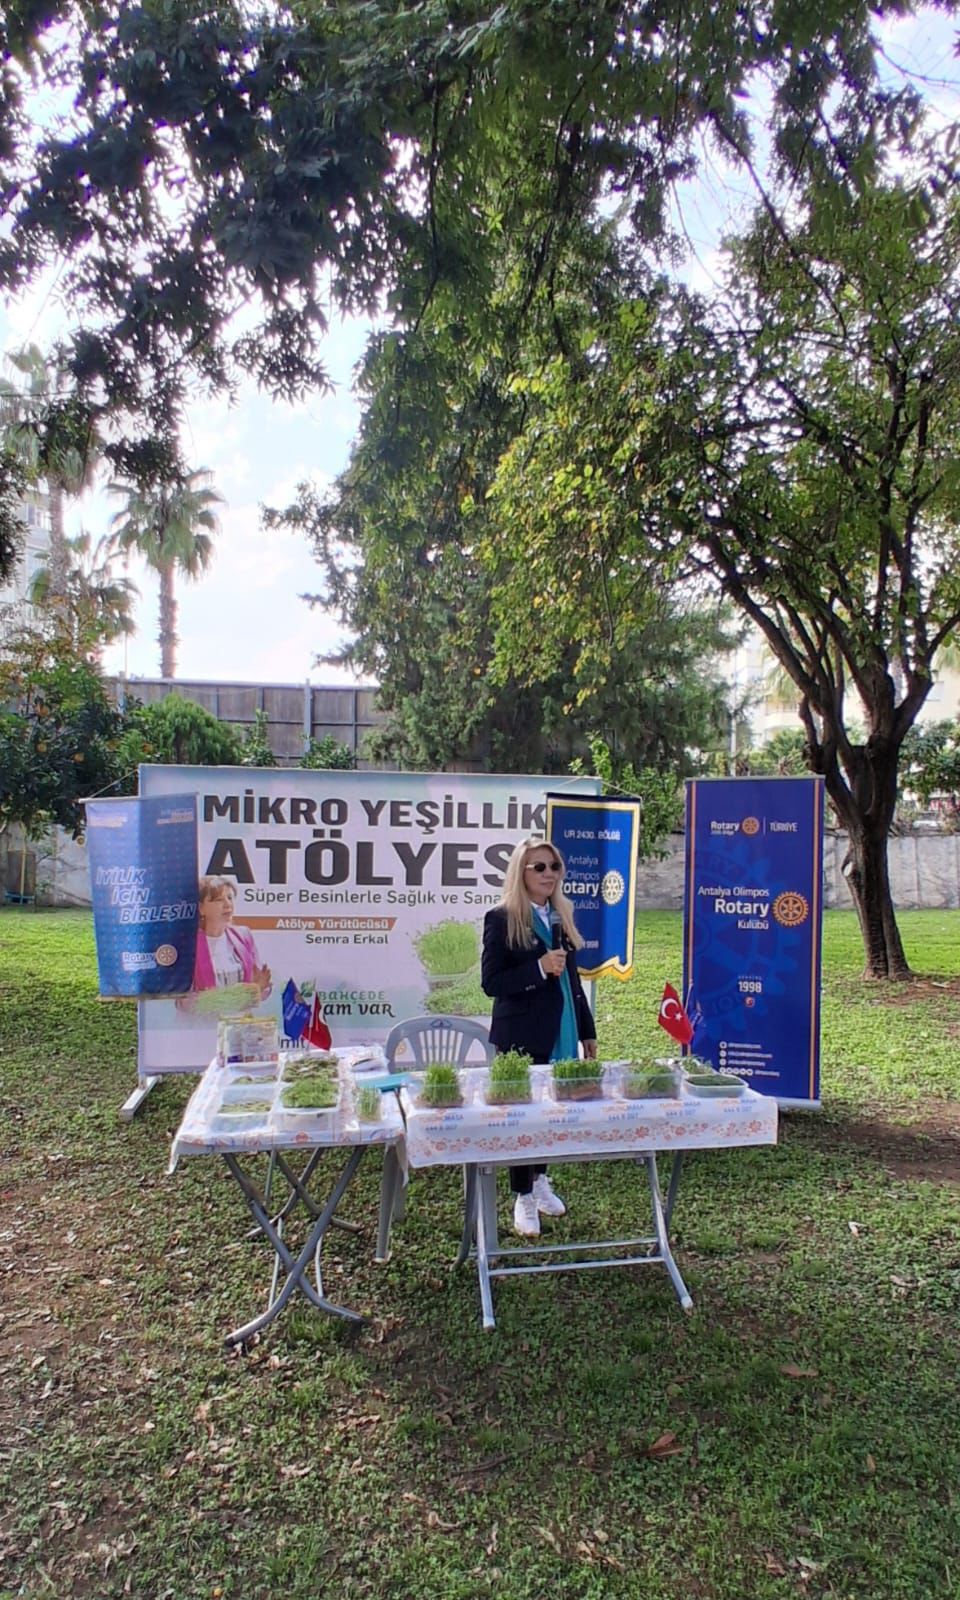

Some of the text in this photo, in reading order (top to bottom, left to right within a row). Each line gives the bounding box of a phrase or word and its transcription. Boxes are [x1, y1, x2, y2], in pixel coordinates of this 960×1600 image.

[203, 789, 546, 834] MİKRO YEŞİLLİK
[710, 821, 739, 832] Rotary
[205, 829, 543, 887] ATÖLYES
[568, 856, 598, 868] Antalya
[244, 888, 293, 905] Süper
[299, 889, 381, 904] Besinlerle
[387, 890, 435, 907] Sağlık
[441, 895, 458, 904] ve
[698, 886, 769, 898] Antalya Olimpos
[714, 899, 769, 917] Rotary
[276, 918, 389, 931] Atölye Yürütücüsü
[737, 919, 769, 930] Kulübü
[306, 934, 389, 945] Semra Erkal
[738, 981, 763, 993] 1998
